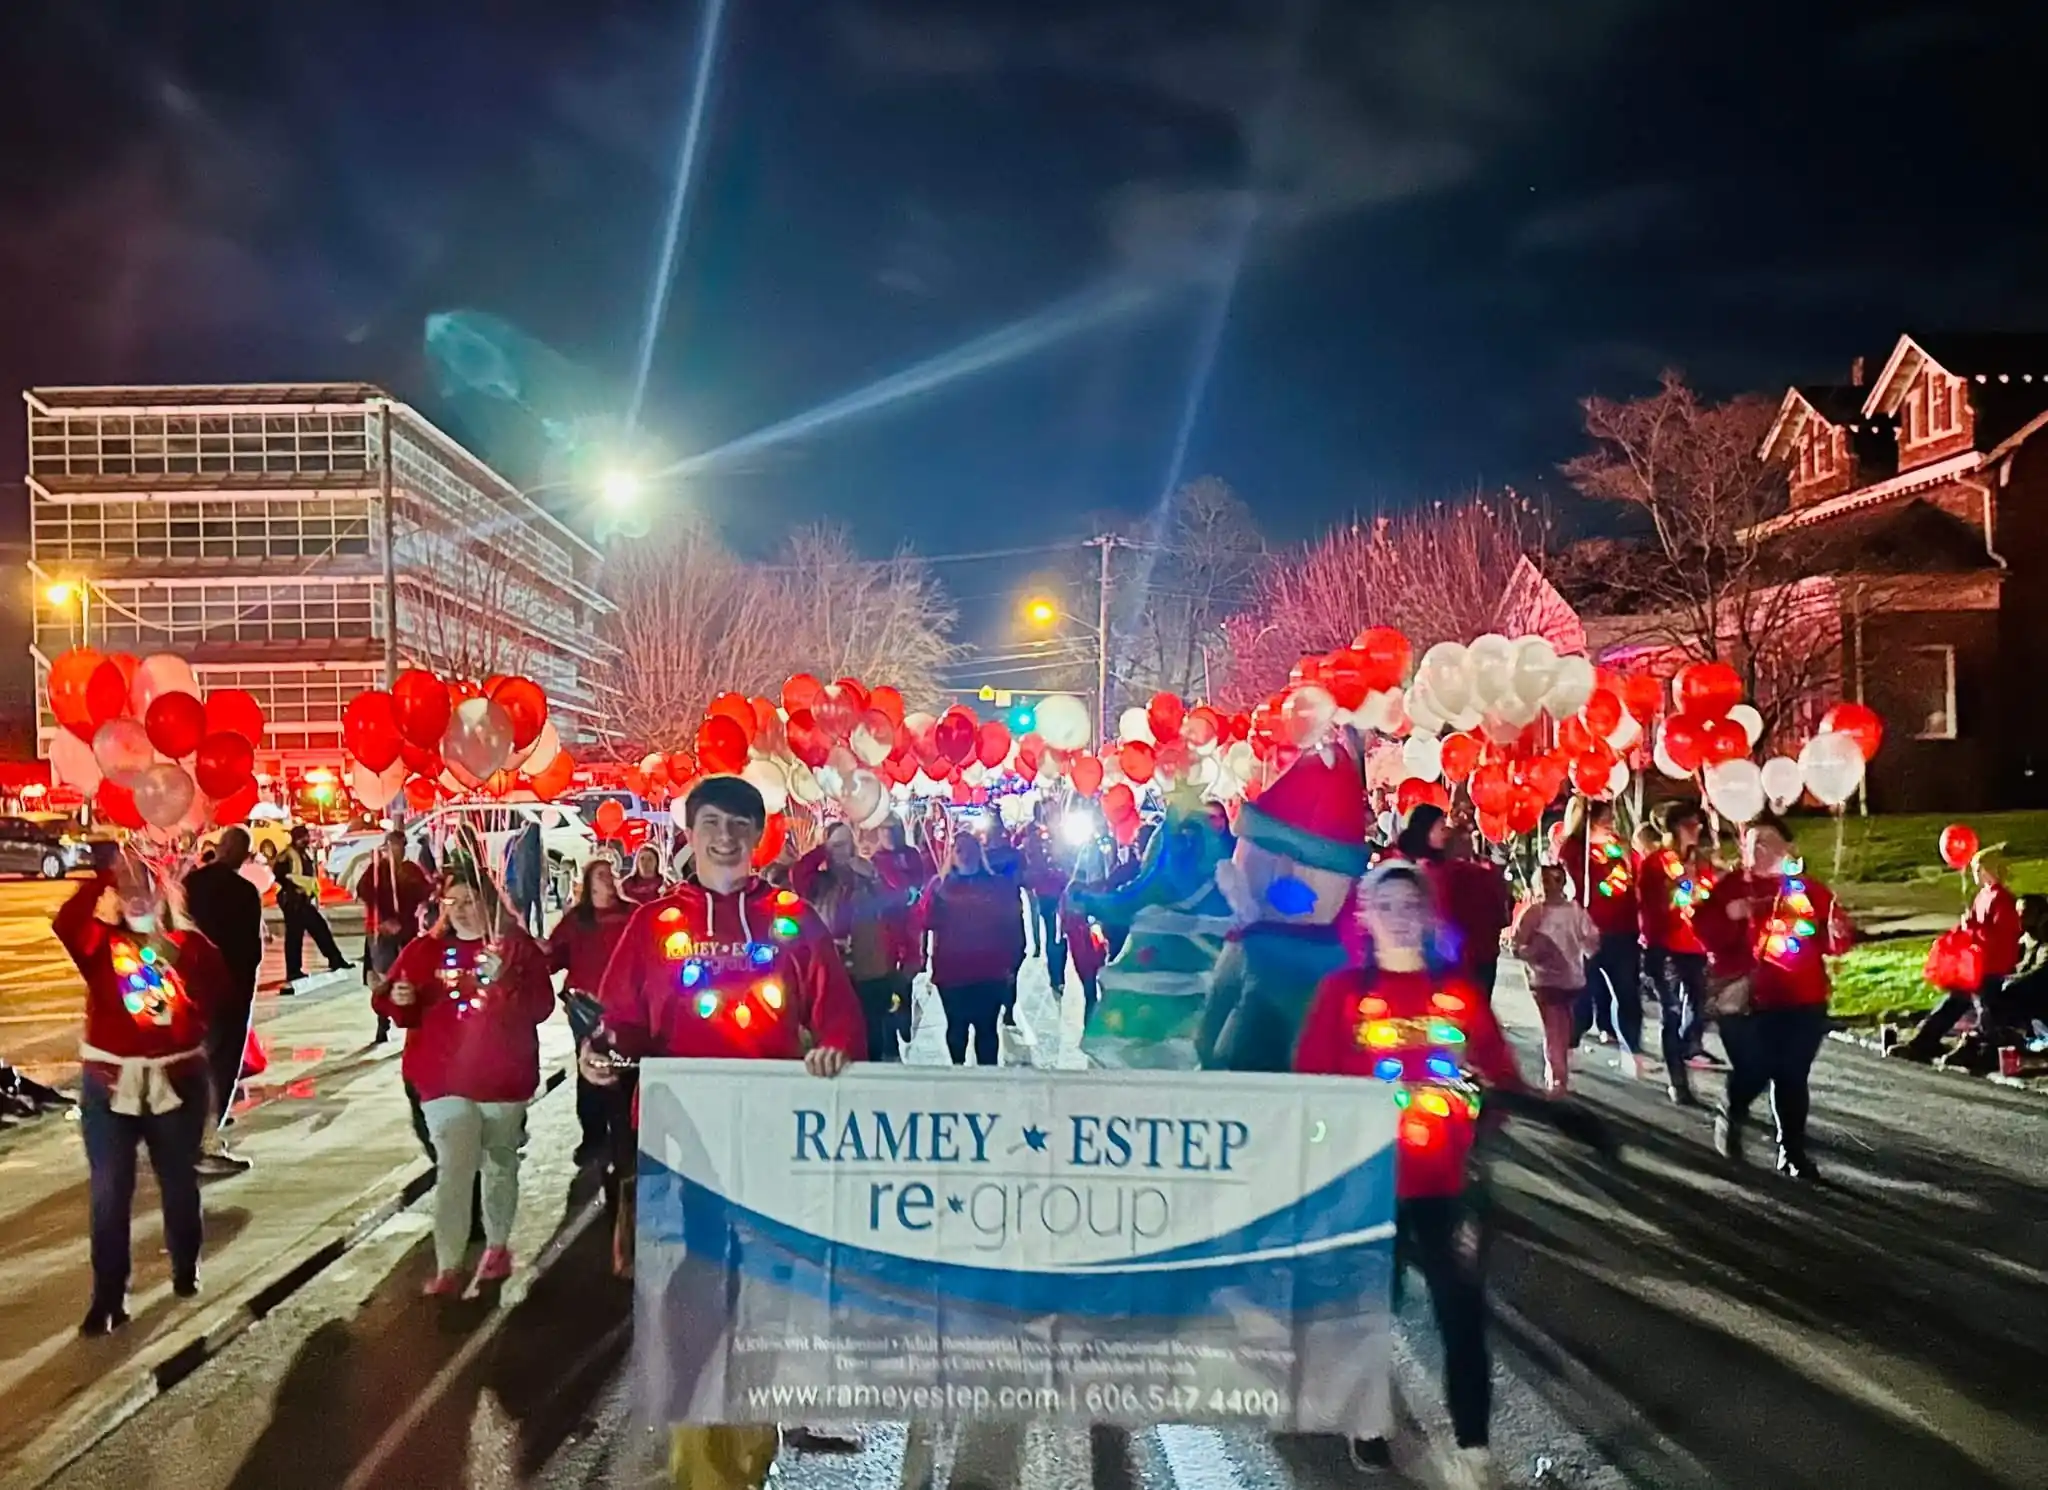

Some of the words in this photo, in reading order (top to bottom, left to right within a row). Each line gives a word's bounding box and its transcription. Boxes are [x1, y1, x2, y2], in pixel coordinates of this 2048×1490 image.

[791, 1109, 1001, 1164] RAMEY
[1068, 1114, 1250, 1172] ESTEP
[748, 1382, 1060, 1415] www.rameyestep.com
